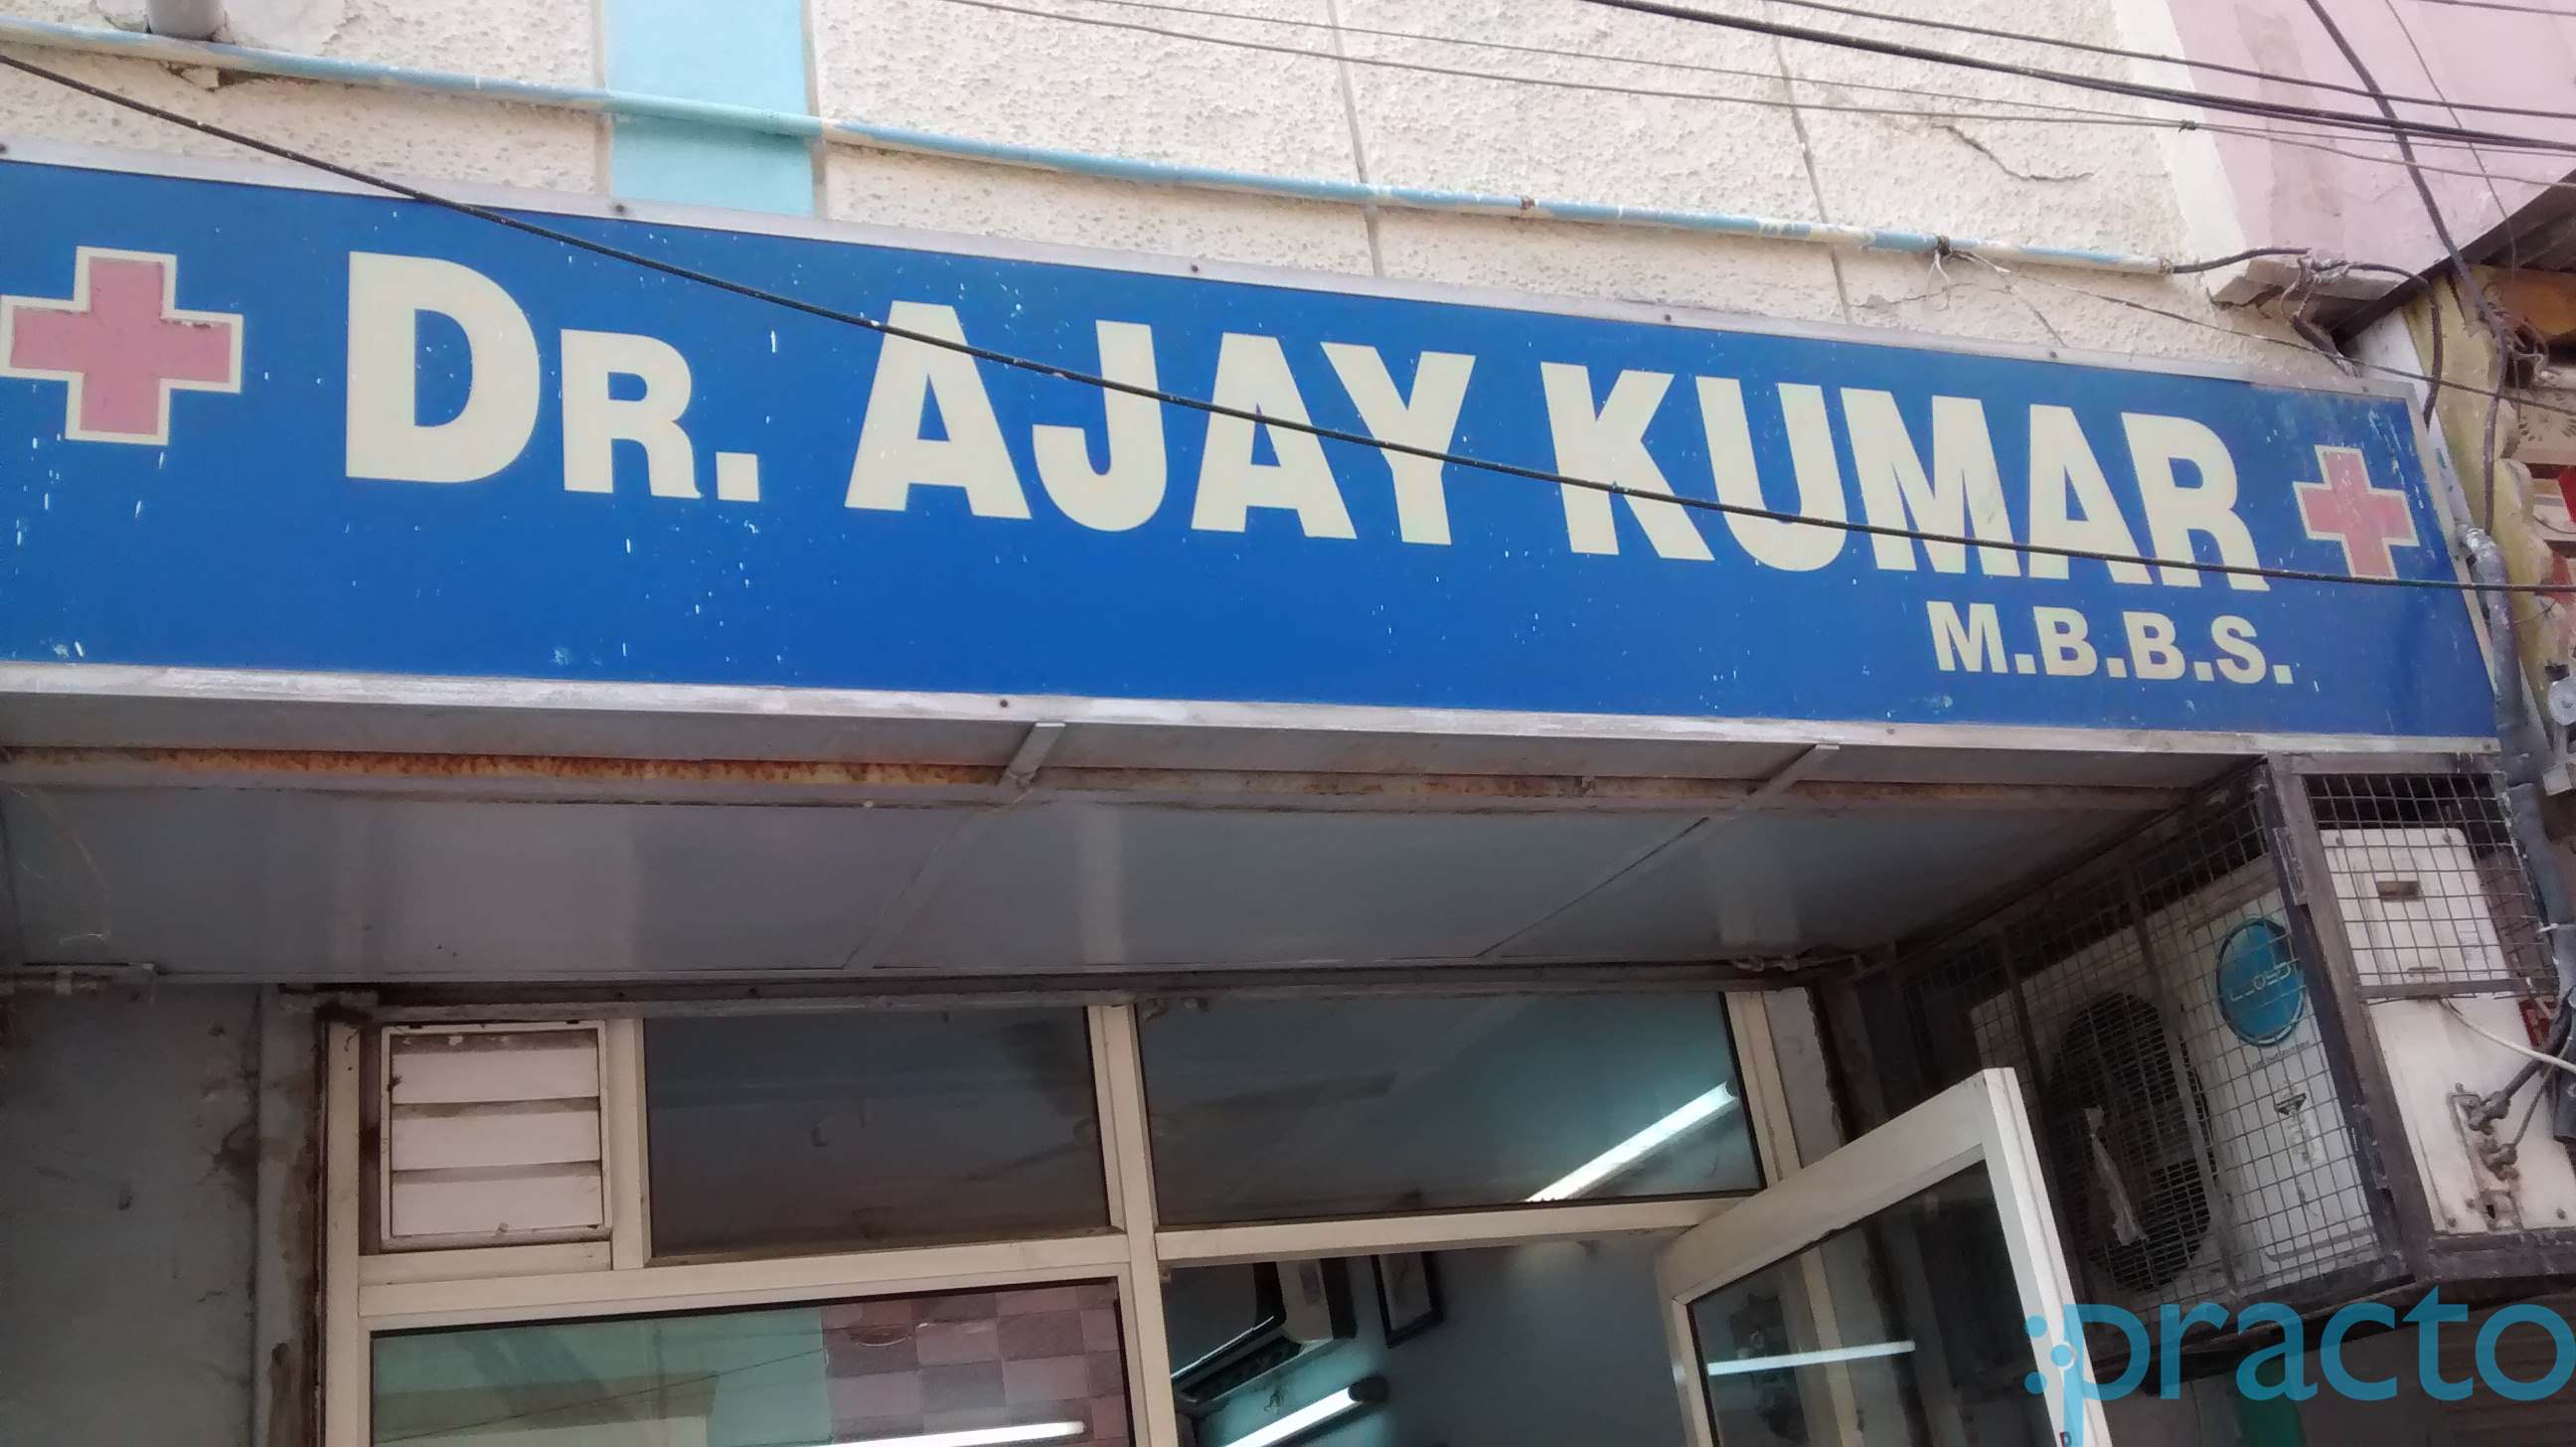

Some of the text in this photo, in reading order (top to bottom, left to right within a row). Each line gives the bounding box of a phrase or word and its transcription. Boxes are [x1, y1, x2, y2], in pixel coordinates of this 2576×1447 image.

[846, 301, 1475, 546] AJAY
[1539, 362, 2271, 592] KUMAR
[1926, 600, 2294, 685] M.B.B.S.
